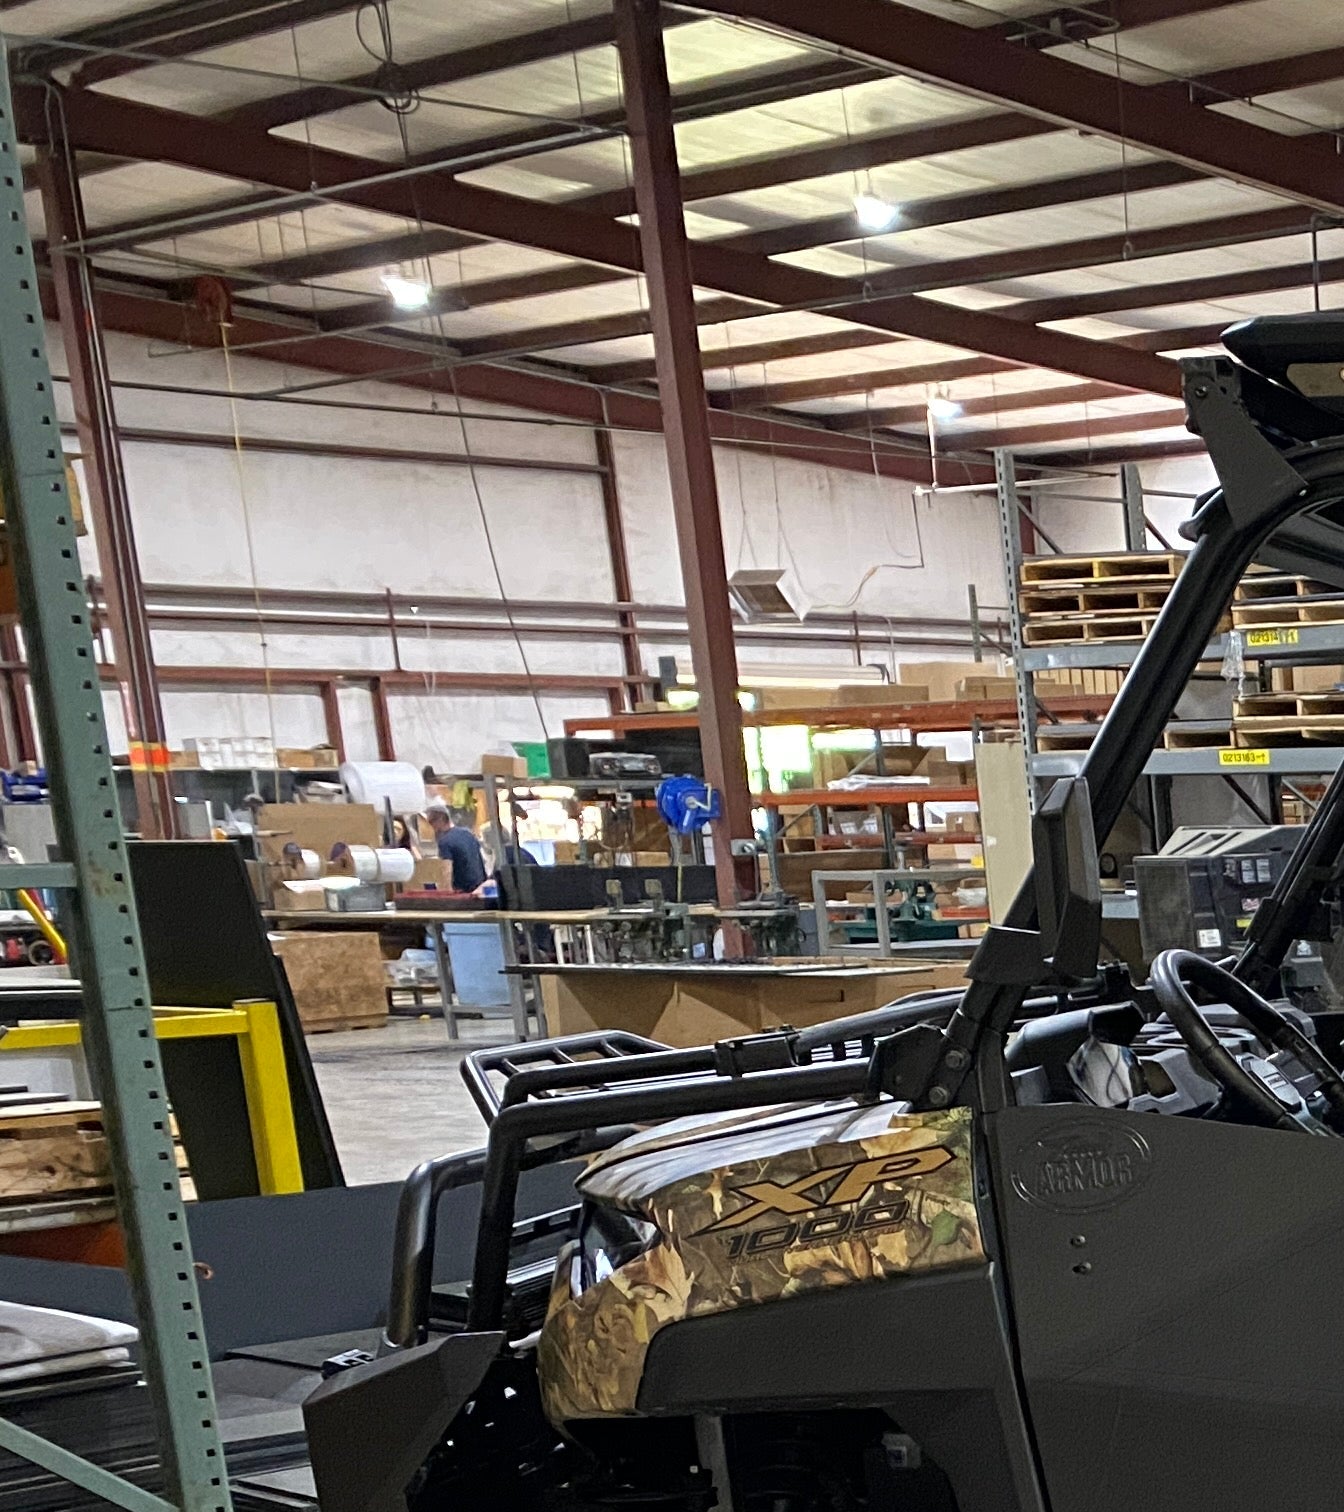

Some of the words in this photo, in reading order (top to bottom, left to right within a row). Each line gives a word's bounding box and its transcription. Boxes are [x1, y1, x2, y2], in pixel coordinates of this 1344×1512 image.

[684, 1144, 958, 1239] XP
[1037, 1153, 1134, 1195] ARMOR
[727, 1200, 911, 1259] 1000
